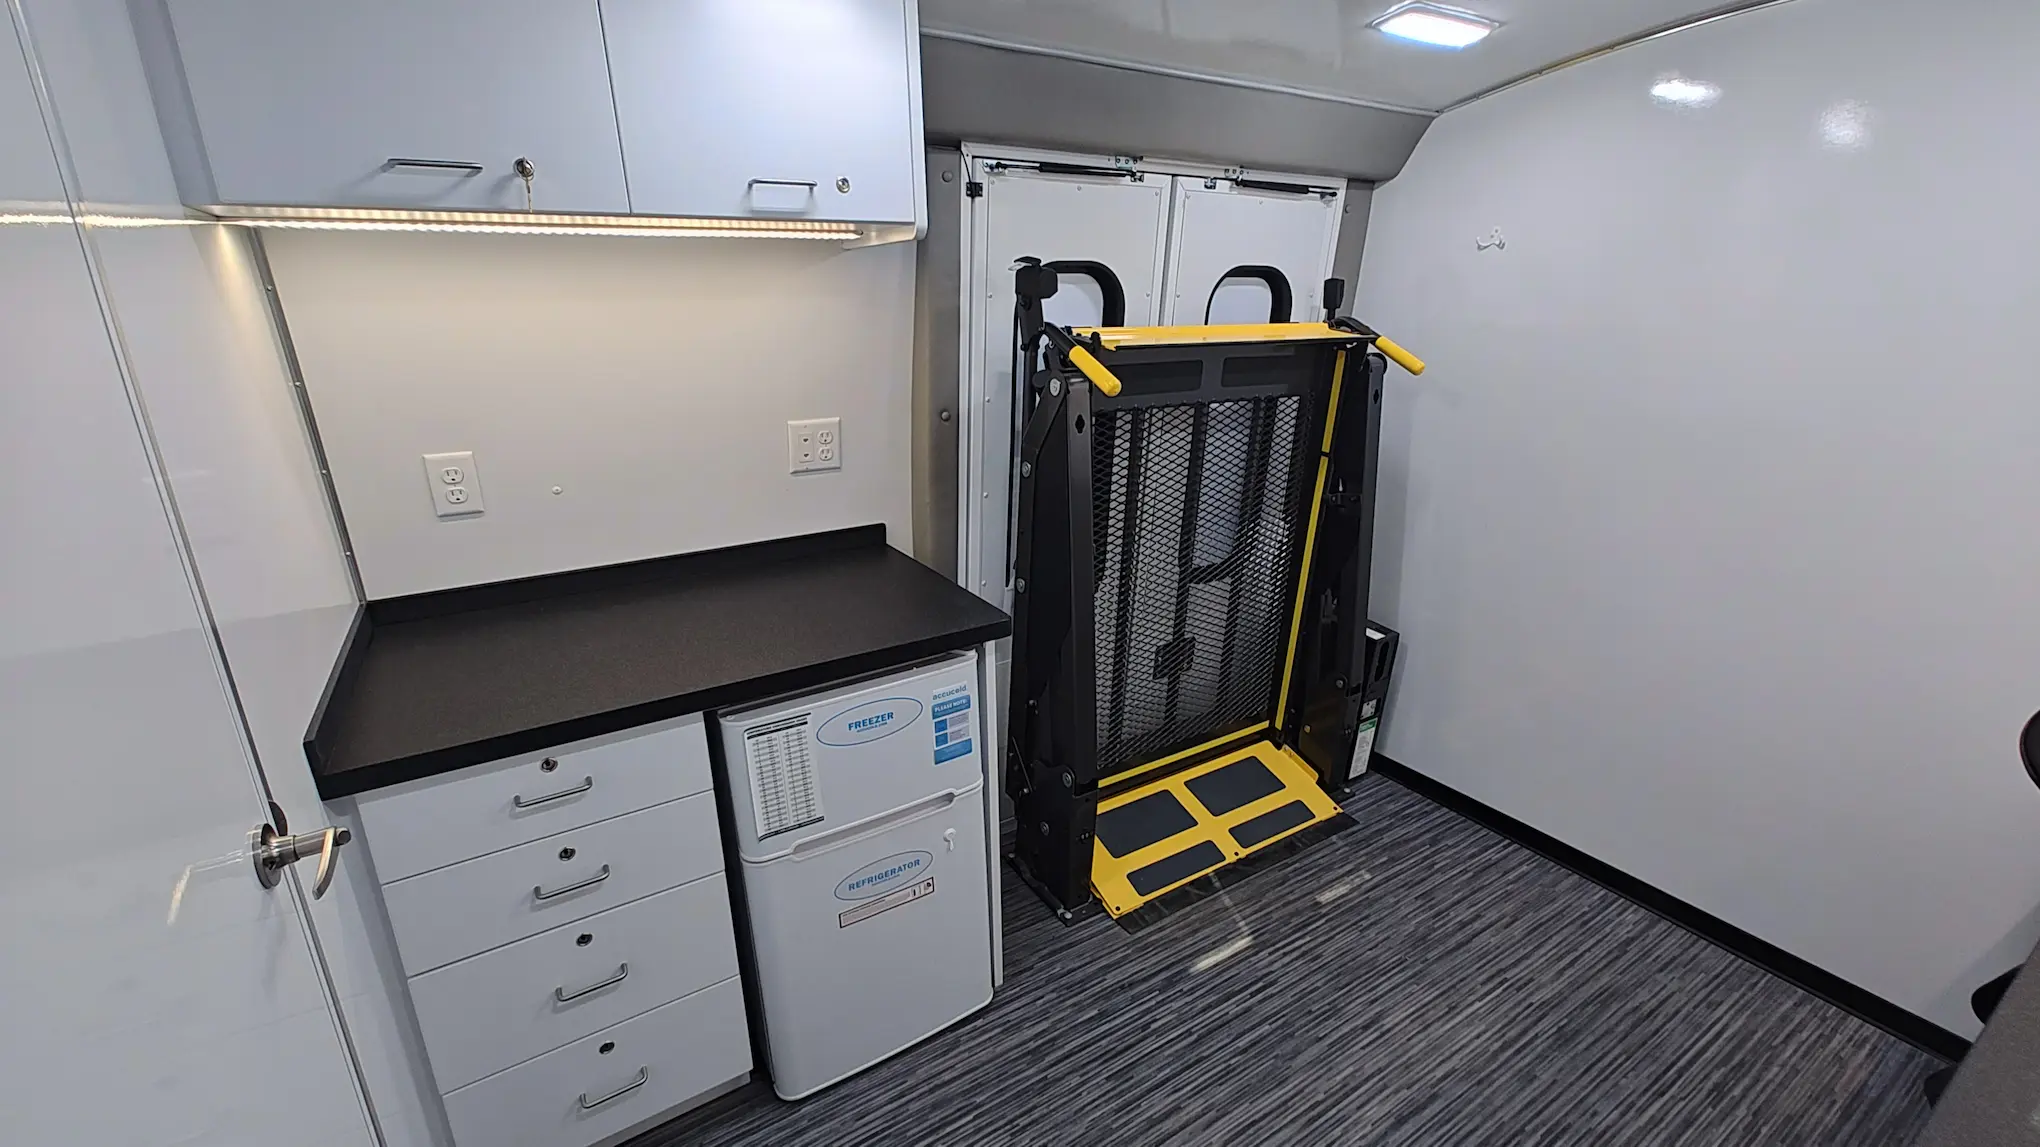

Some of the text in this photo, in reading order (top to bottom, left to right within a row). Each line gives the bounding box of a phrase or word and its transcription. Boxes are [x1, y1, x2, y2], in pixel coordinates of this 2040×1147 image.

[932, 684, 967, 700] accucold
[934, 703, 953, 712] PLEASE
[848, 711, 894, 731] FREEZER
[848, 859, 920, 891] REFRIGERATOR
